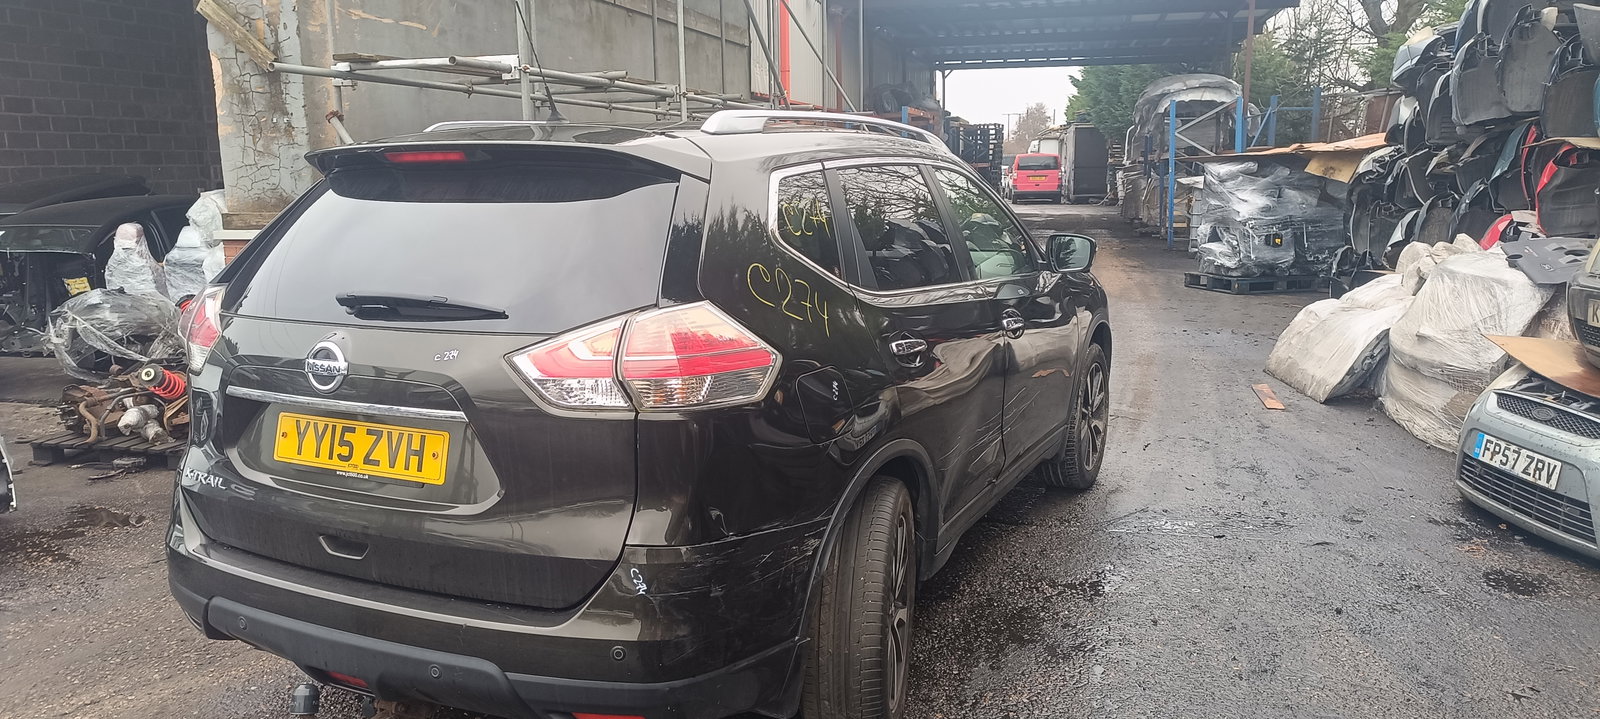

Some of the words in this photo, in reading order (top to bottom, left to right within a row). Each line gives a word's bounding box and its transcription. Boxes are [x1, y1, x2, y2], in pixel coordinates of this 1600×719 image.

[747, 263, 830, 338] C274
[307, 361, 341, 374] NISSAN
[295, 419, 356, 463] YY15
[363, 428, 426, 472] ZVH
[1482, 438, 1521, 470] FP57
[1521, 454, 1557, 485] ZRV
[185, 467, 228, 490] X-TRAIL
